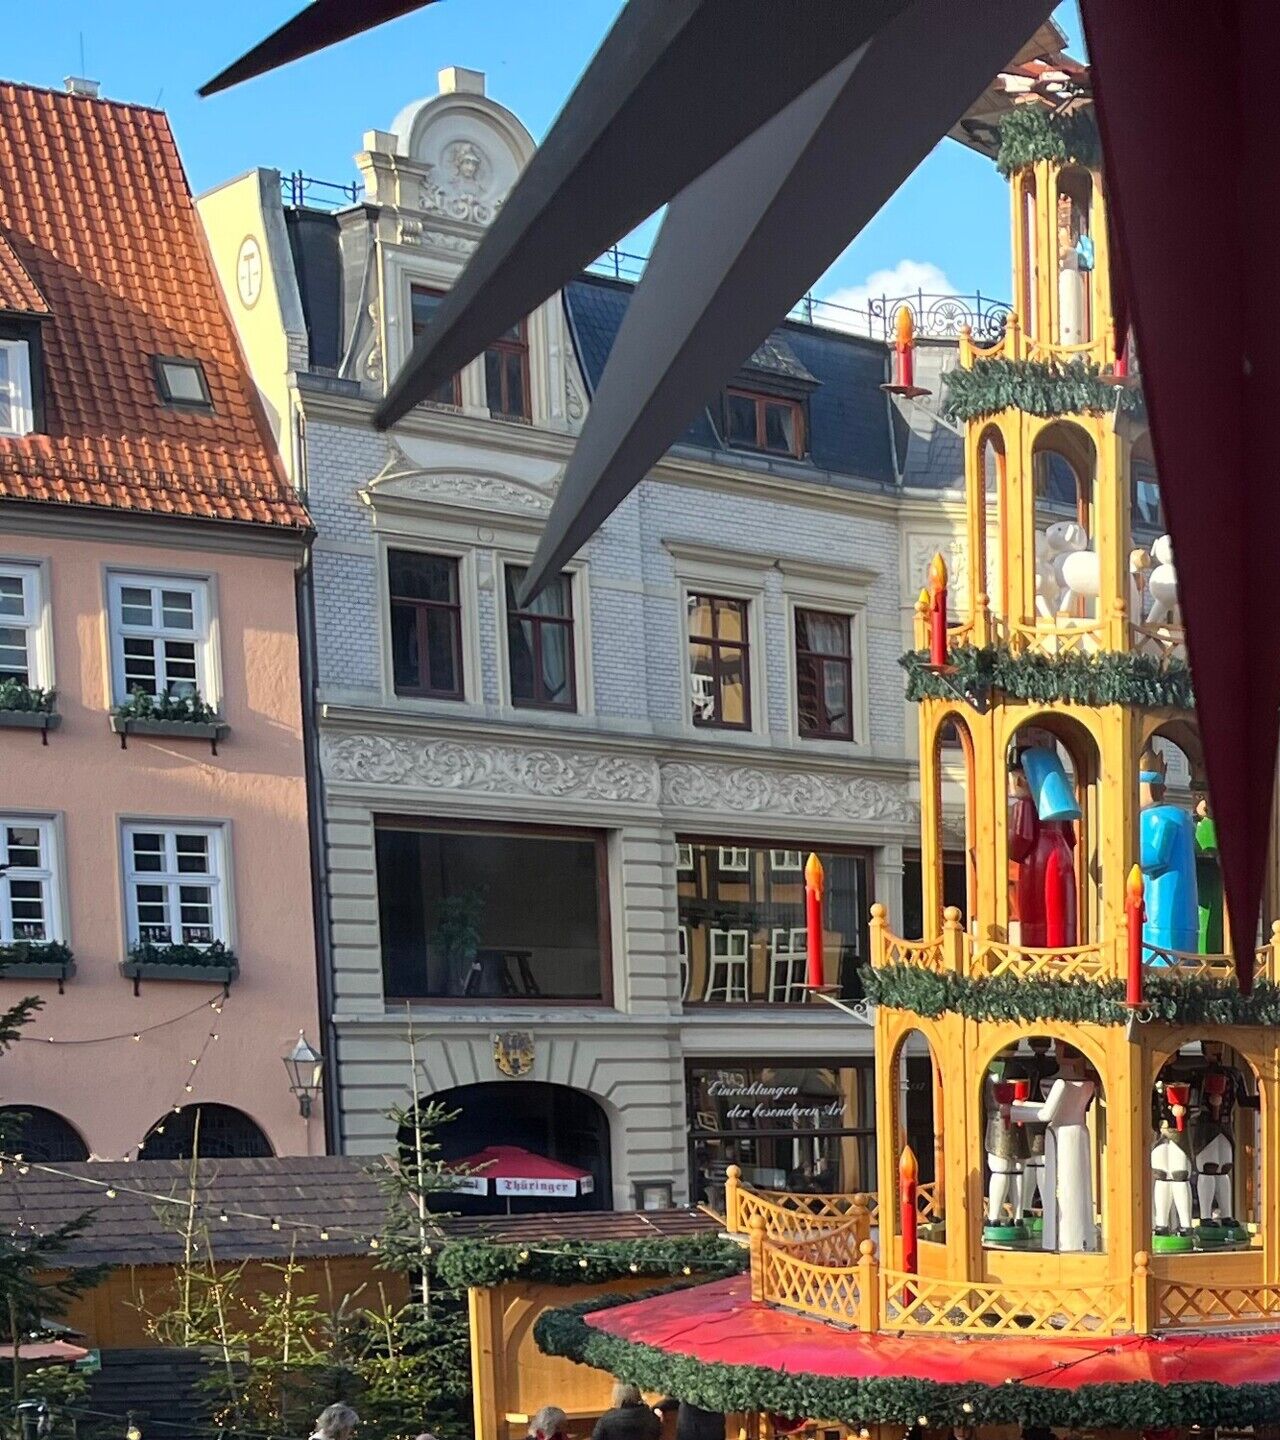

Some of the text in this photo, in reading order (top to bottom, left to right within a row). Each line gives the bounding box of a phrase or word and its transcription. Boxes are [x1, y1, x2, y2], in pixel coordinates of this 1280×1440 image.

[708, 1080, 798, 1100] Einrichtungen
[727, 1103, 750, 1118] der
[752, 1102, 819, 1118] besonderen
[504, 1179, 568, 1193] Thüringer
